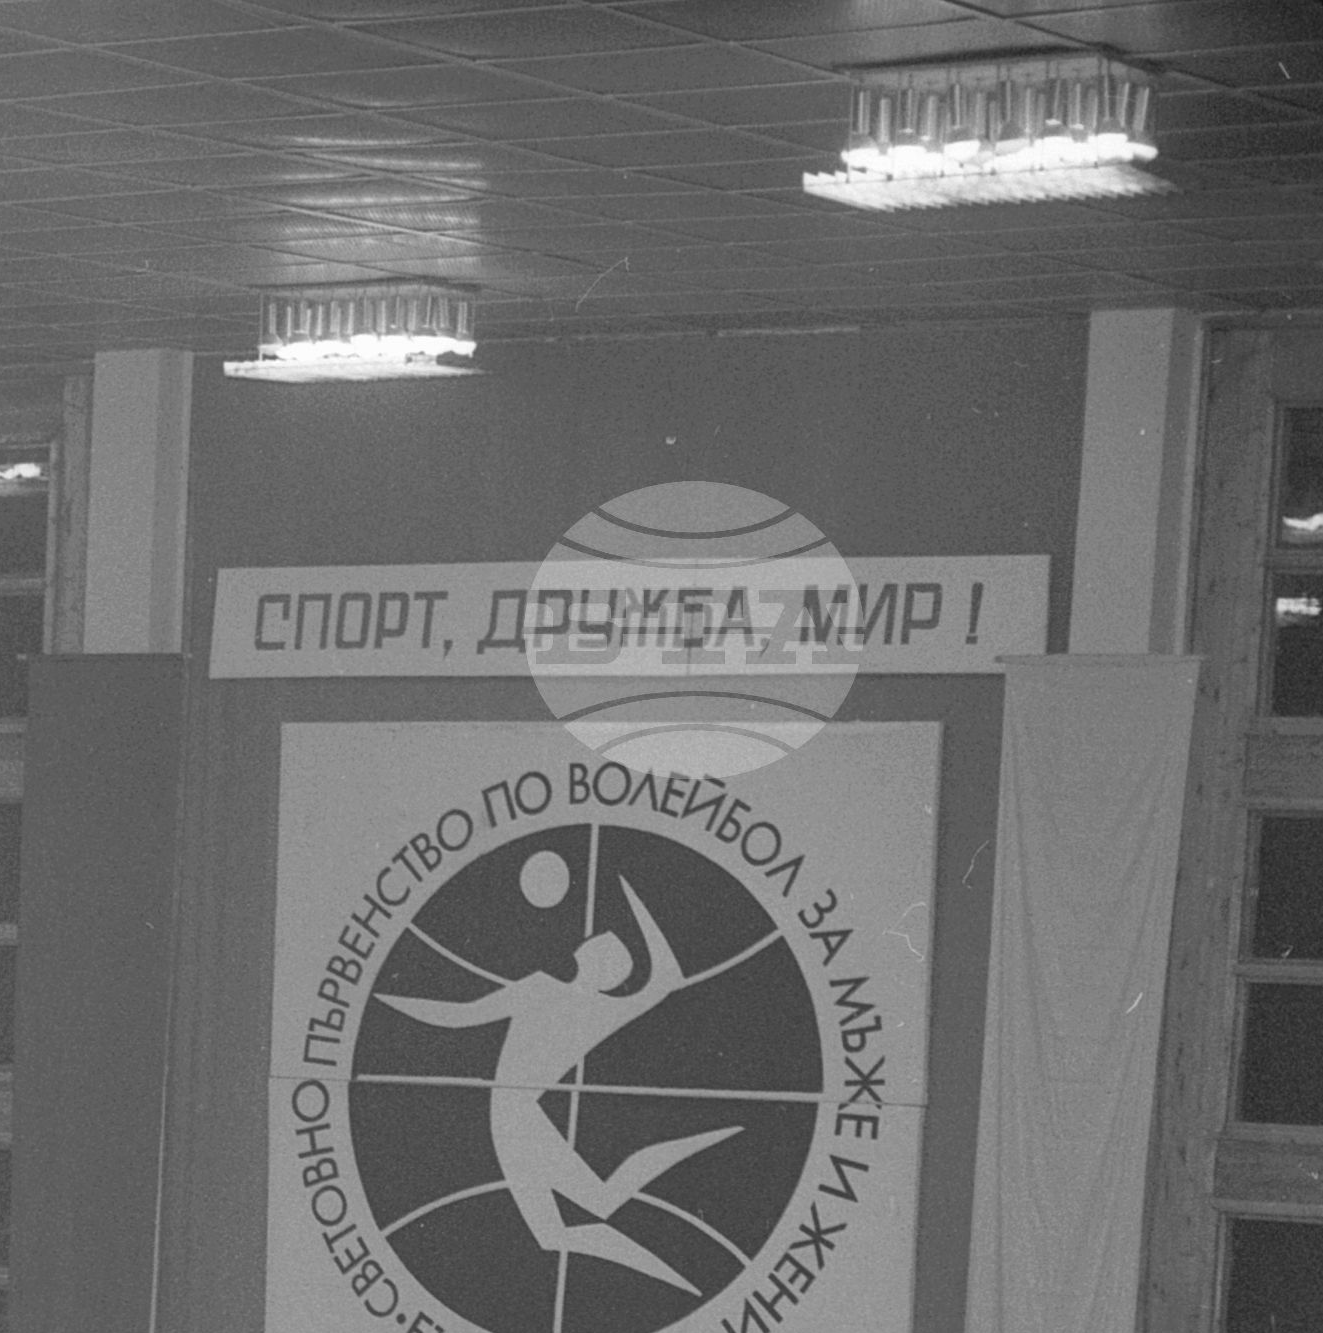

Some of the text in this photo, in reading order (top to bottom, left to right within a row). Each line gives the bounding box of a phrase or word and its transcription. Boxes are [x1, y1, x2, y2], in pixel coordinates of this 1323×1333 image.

[255, 591, 453, 660] СПОРТ,
[798, 581, 944, 647] МИР
[481, 770, 553, 828] ПО
[568, 760, 806, 898] ВОЛЕЙБОЛ
[302, 808, 475, 1068] ПЪРВЕНСТВО
[797, 889, 855, 963] ЗА
[829, 975, 886, 1141] МЪЖЕ
[291, 1078, 400, 1319] СВЕТОВНО
[817, 1154, 870, 1205] И
